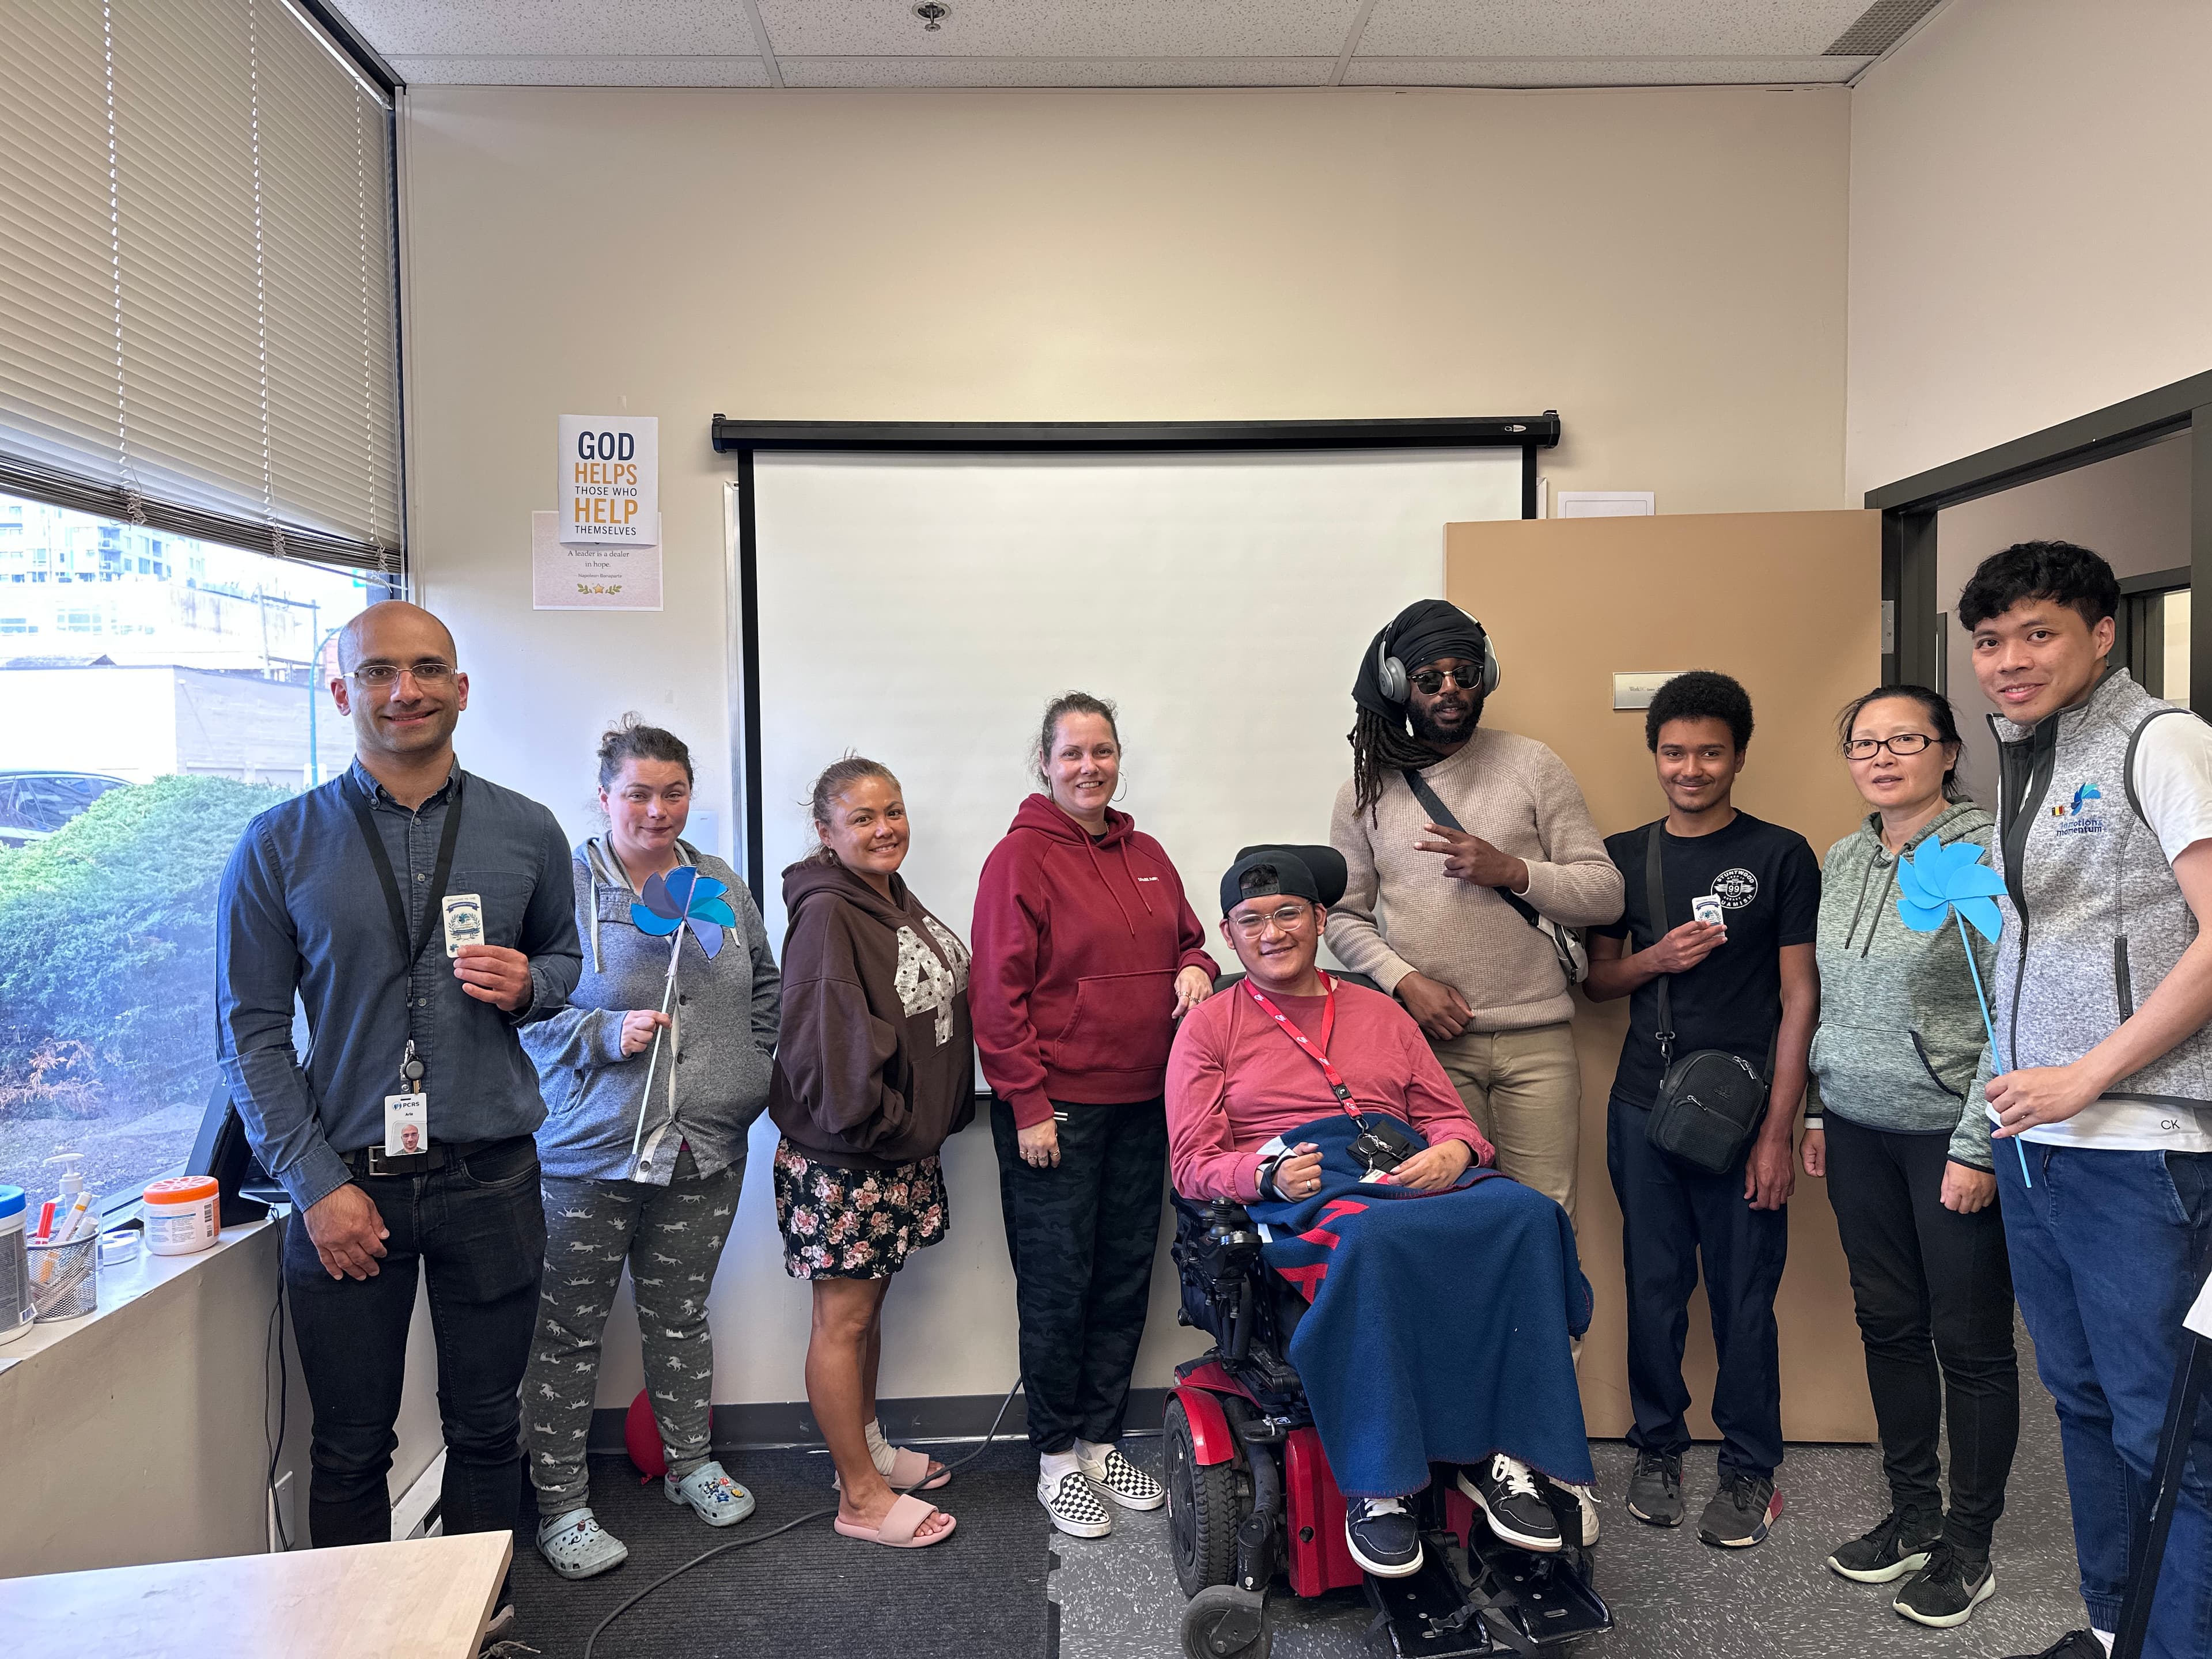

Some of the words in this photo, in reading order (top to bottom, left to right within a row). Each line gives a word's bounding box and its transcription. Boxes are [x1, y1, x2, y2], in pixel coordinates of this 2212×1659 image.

[578, 431, 634, 461] GOD
[575, 462, 637, 485] HELPS
[575, 486, 609, 495] THOSE
[612, 487, 637, 497] WHO
[575, 497, 638, 524] HELP
[575, 525, 637, 536] THEMSELVES
[593, 560, 611, 569] hope.
[1717, 870, 1755, 883] STUNTWOOD
[1728, 885, 1740, 893] 99
[2161, 1119, 2180, 1130] CK
